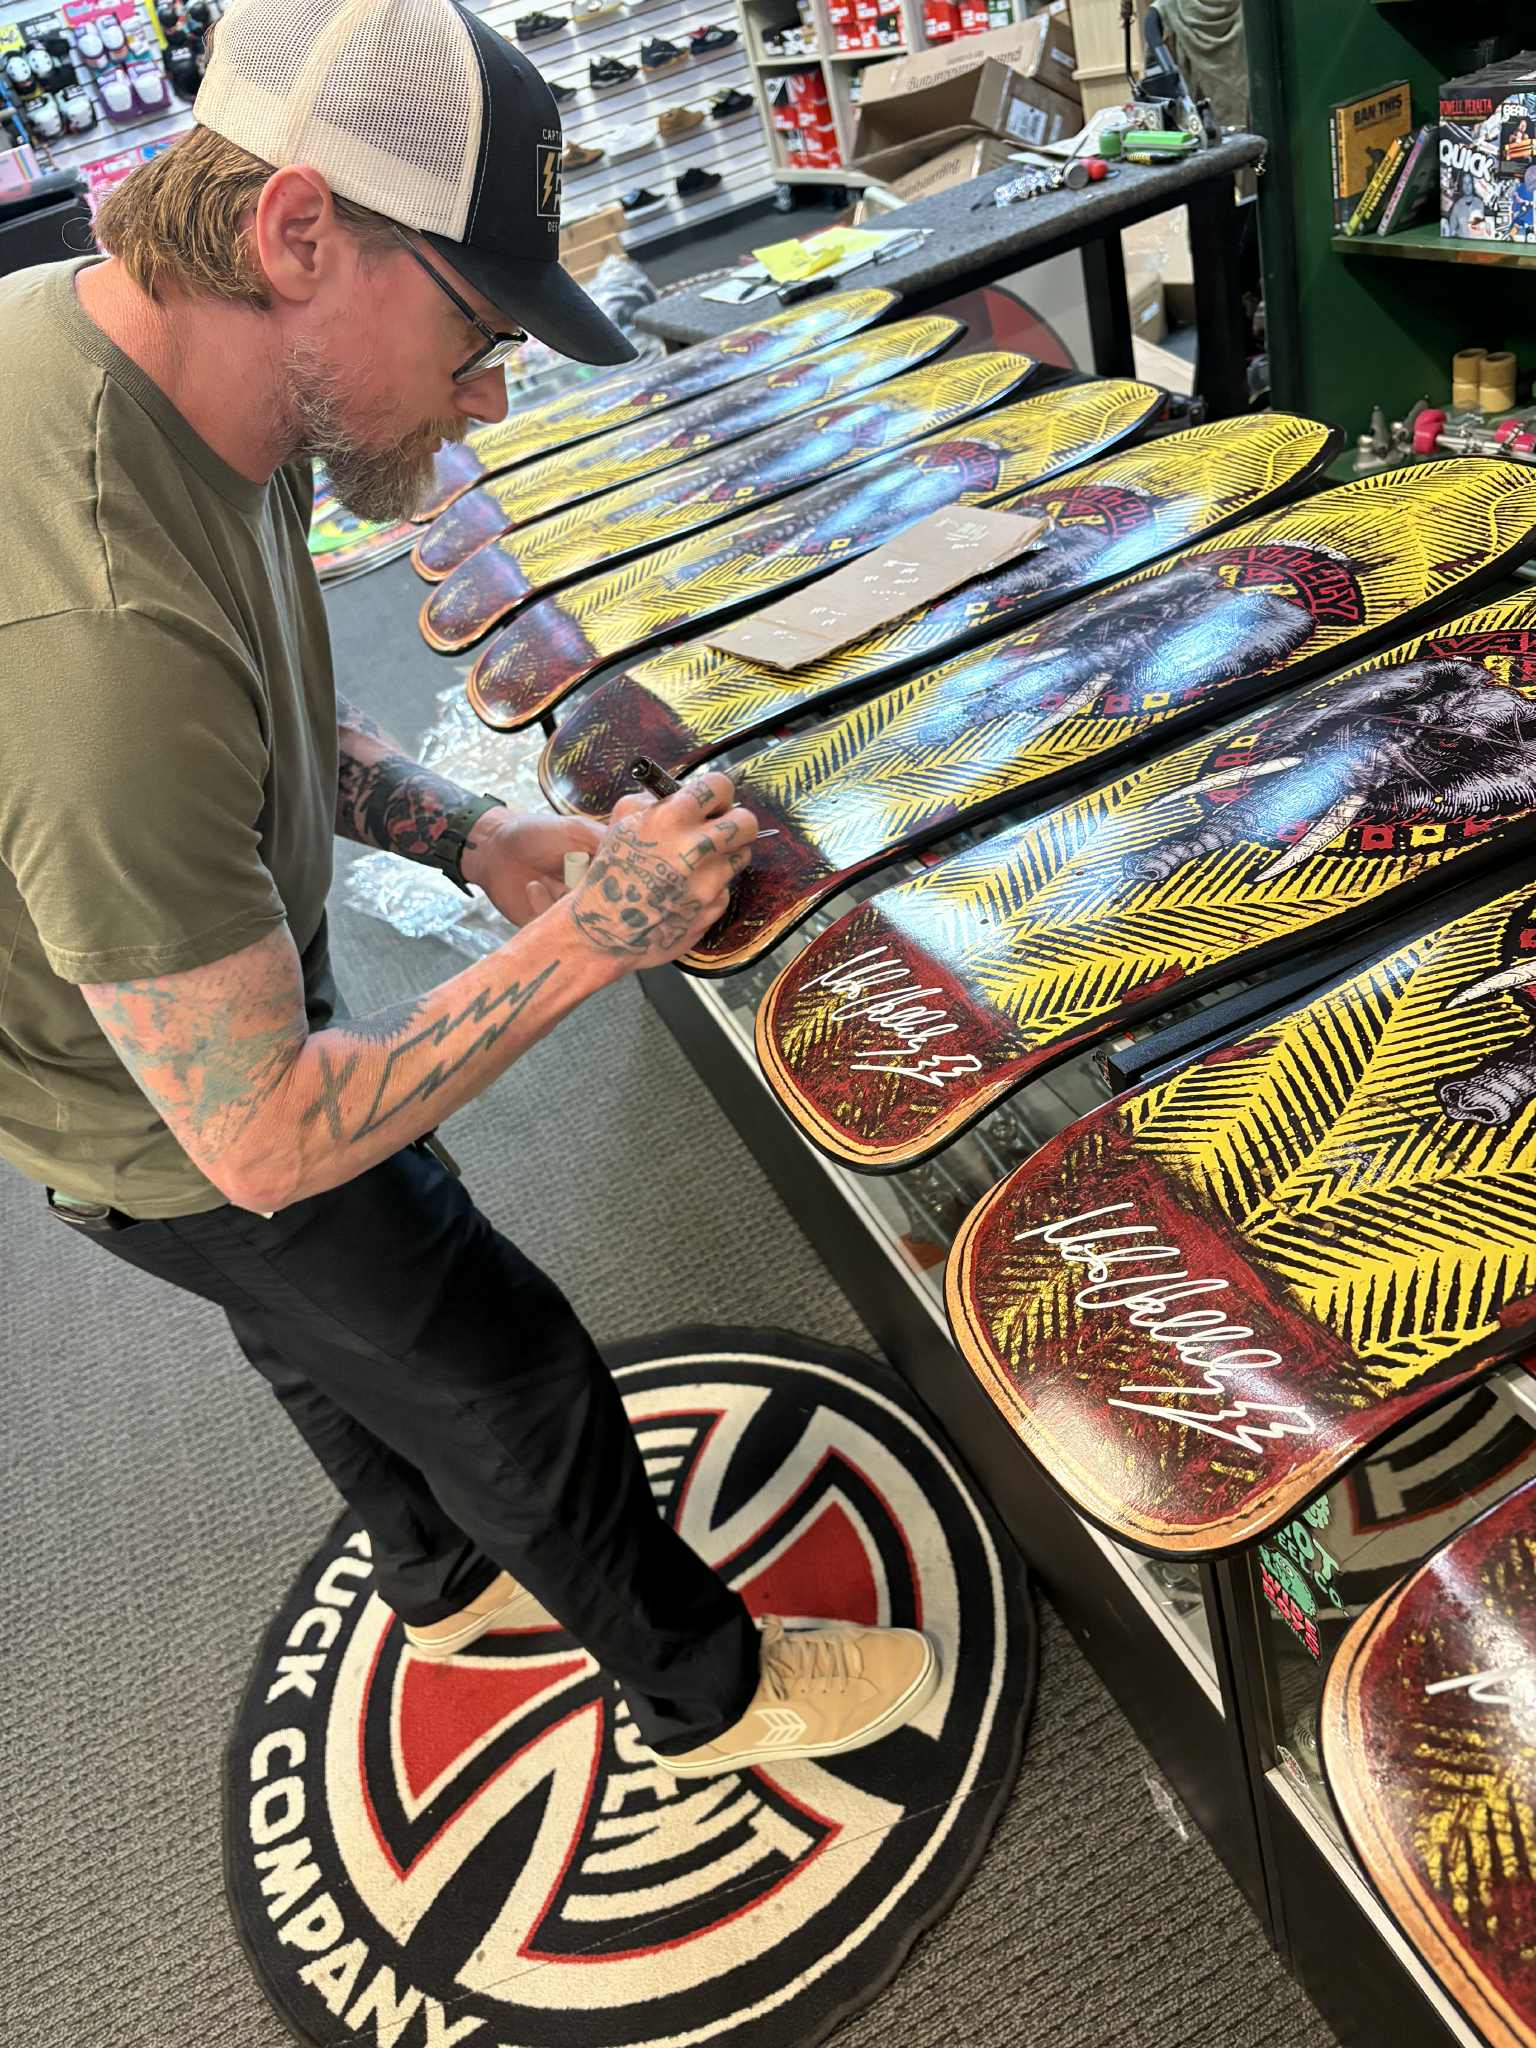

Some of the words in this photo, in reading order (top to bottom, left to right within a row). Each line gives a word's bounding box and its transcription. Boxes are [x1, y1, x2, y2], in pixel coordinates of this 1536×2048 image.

[1378, 94, 1402, 115] THIS
[1439, 139, 1494, 182] QUICK
[265, 1529, 374, 1703] UCK
[249, 1726, 489, 2048] COMPANY
